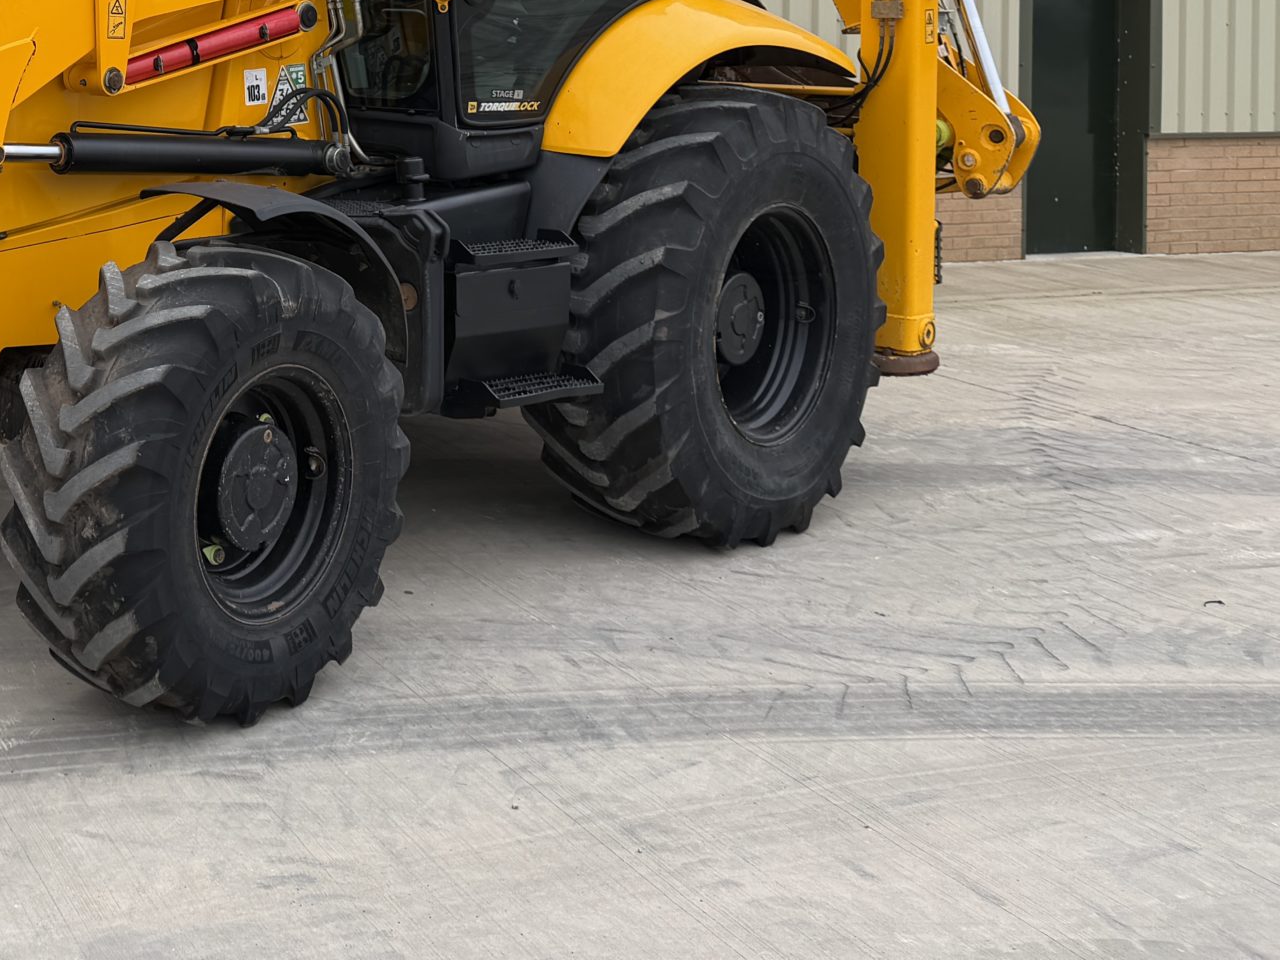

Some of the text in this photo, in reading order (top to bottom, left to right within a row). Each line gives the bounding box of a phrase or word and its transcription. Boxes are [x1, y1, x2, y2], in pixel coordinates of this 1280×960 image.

[247, 84, 260, 102] 103
[491, 89, 514, 99] STAGE
[479, 101, 540, 111] TORQUELOCK
